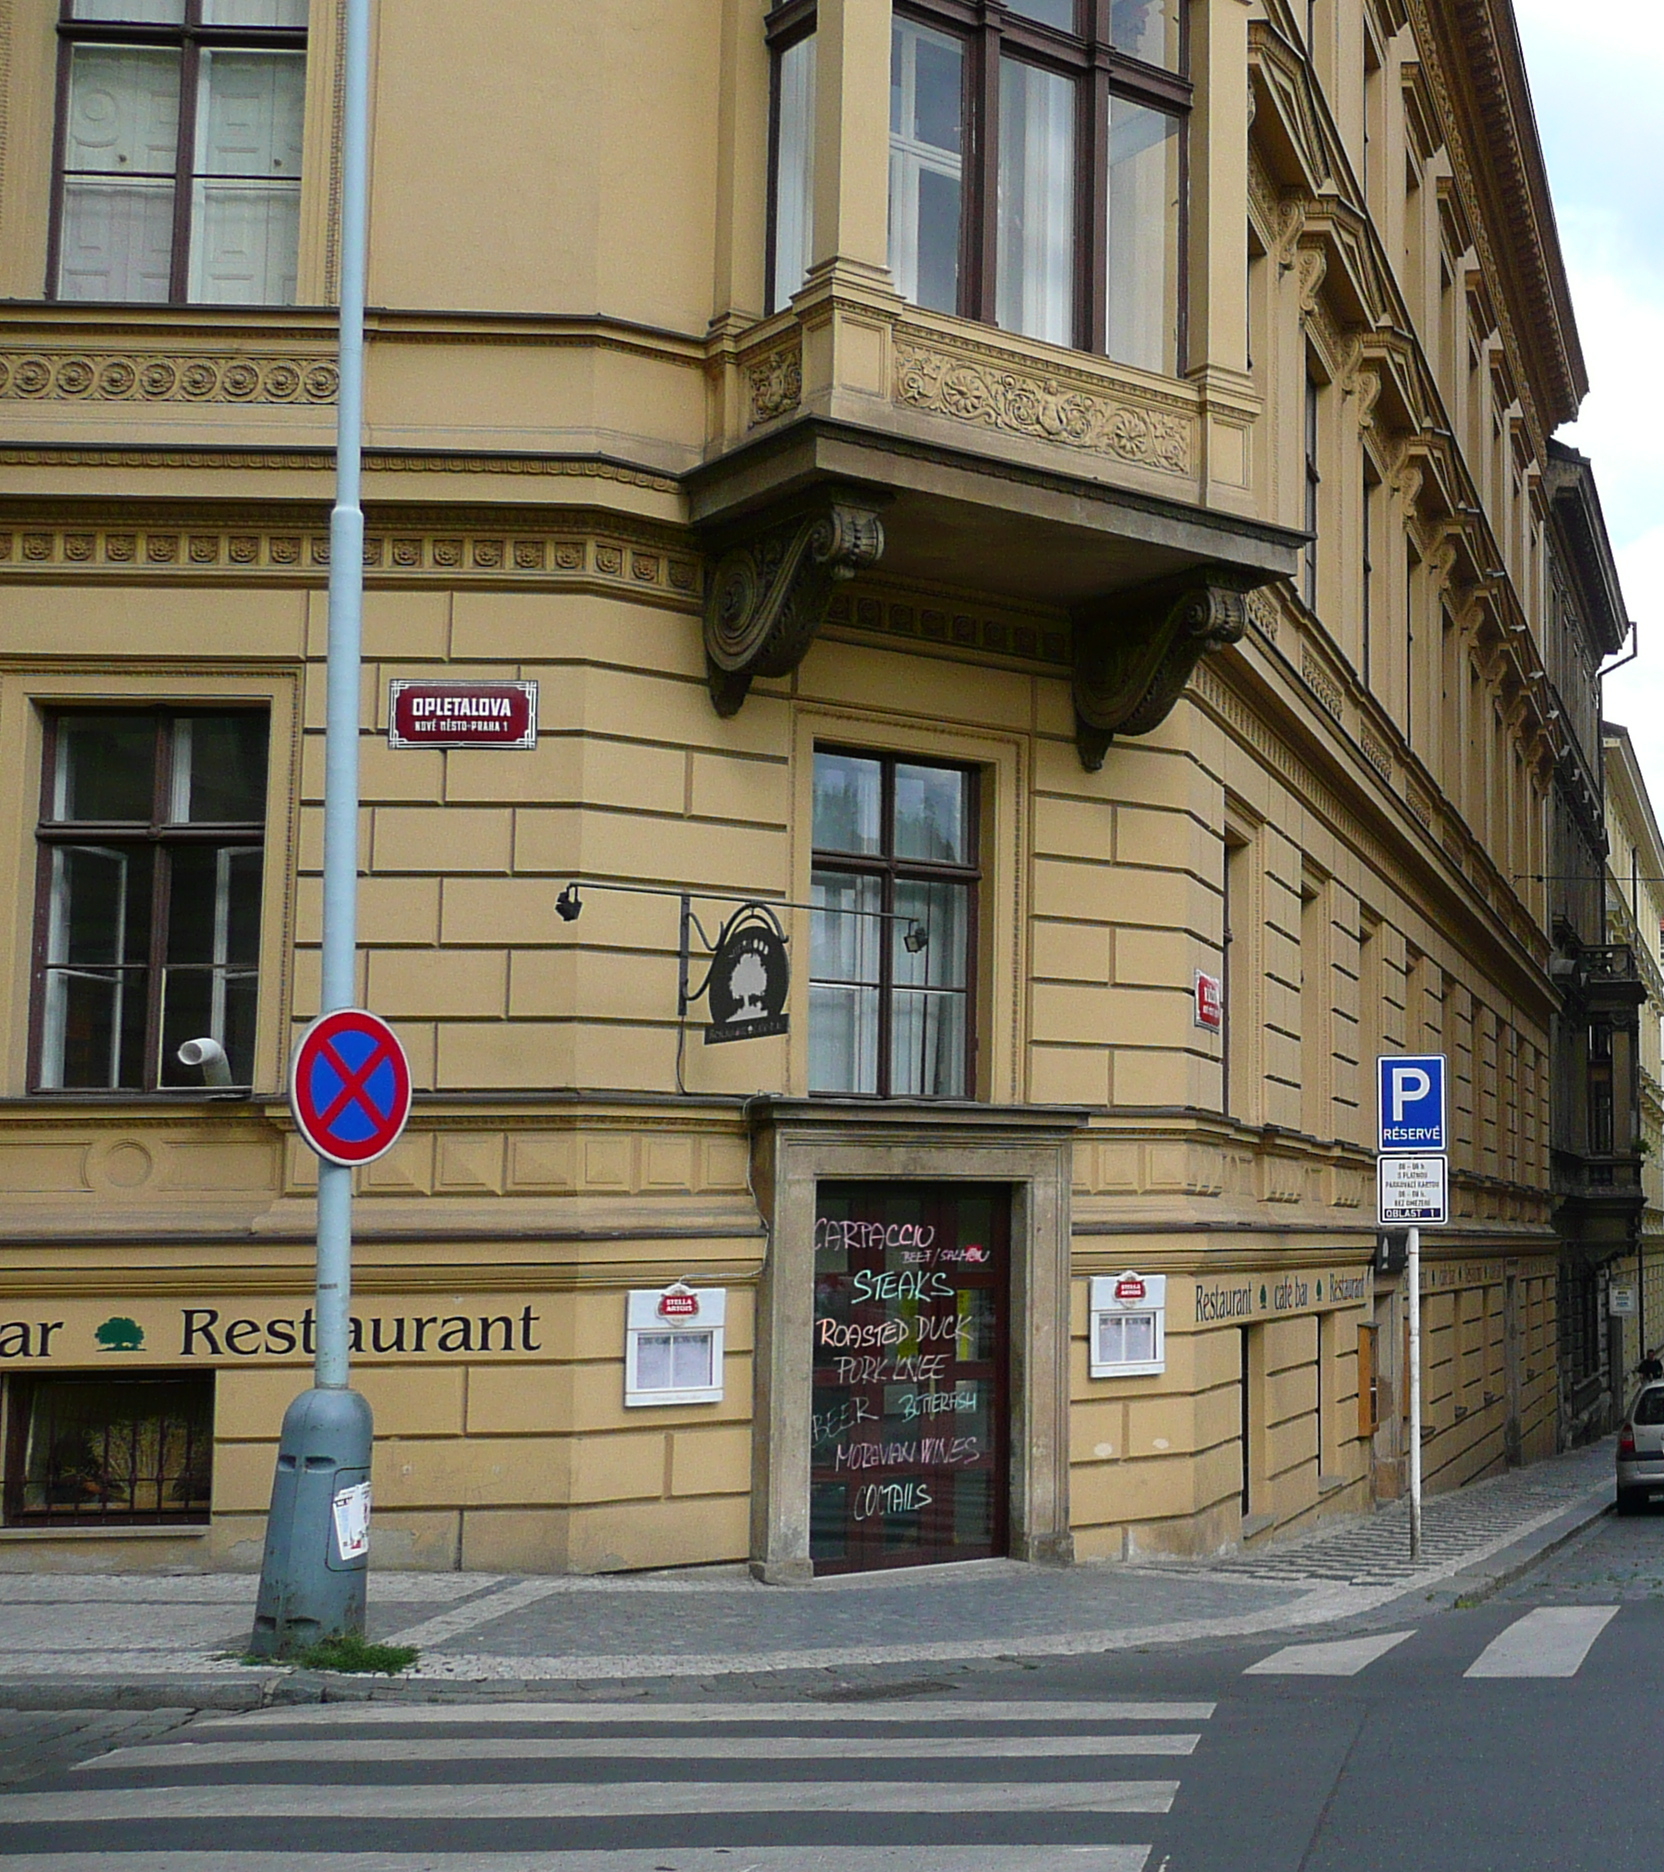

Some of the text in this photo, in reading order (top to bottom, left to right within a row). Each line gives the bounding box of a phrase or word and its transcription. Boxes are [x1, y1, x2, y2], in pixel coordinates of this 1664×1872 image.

[412, 697, 512, 717] OPLETALOVA
[414, 718, 437, 732] NOVÉ
[503, 720, 509, 732] 1
[1392, 1067, 1431, 1122] P
[1383, 1125, 1441, 1141] RÉSERVÉ
[1386, 1209, 1423, 1218] OBLAST
[814, 1217, 935, 1251] CARPACCIO
[851, 1269, 955, 1304] STEAKS
[1195, 1280, 1253, 1323] Restaurant
[1295, 1276, 1308, 1308] bar
[1329, 1271, 1366, 1303] Restaurant
[180, 1304, 542, 1356] Restaurant
[815, 1314, 974, 1348] ROASTED DUCK
[833, 1353, 952, 1384] PORK KNEE
[812, 1396, 880, 1448] BEER
[921, 1436, 980, 1465] WINES
[853, 1483, 933, 1521] COCTAILS
